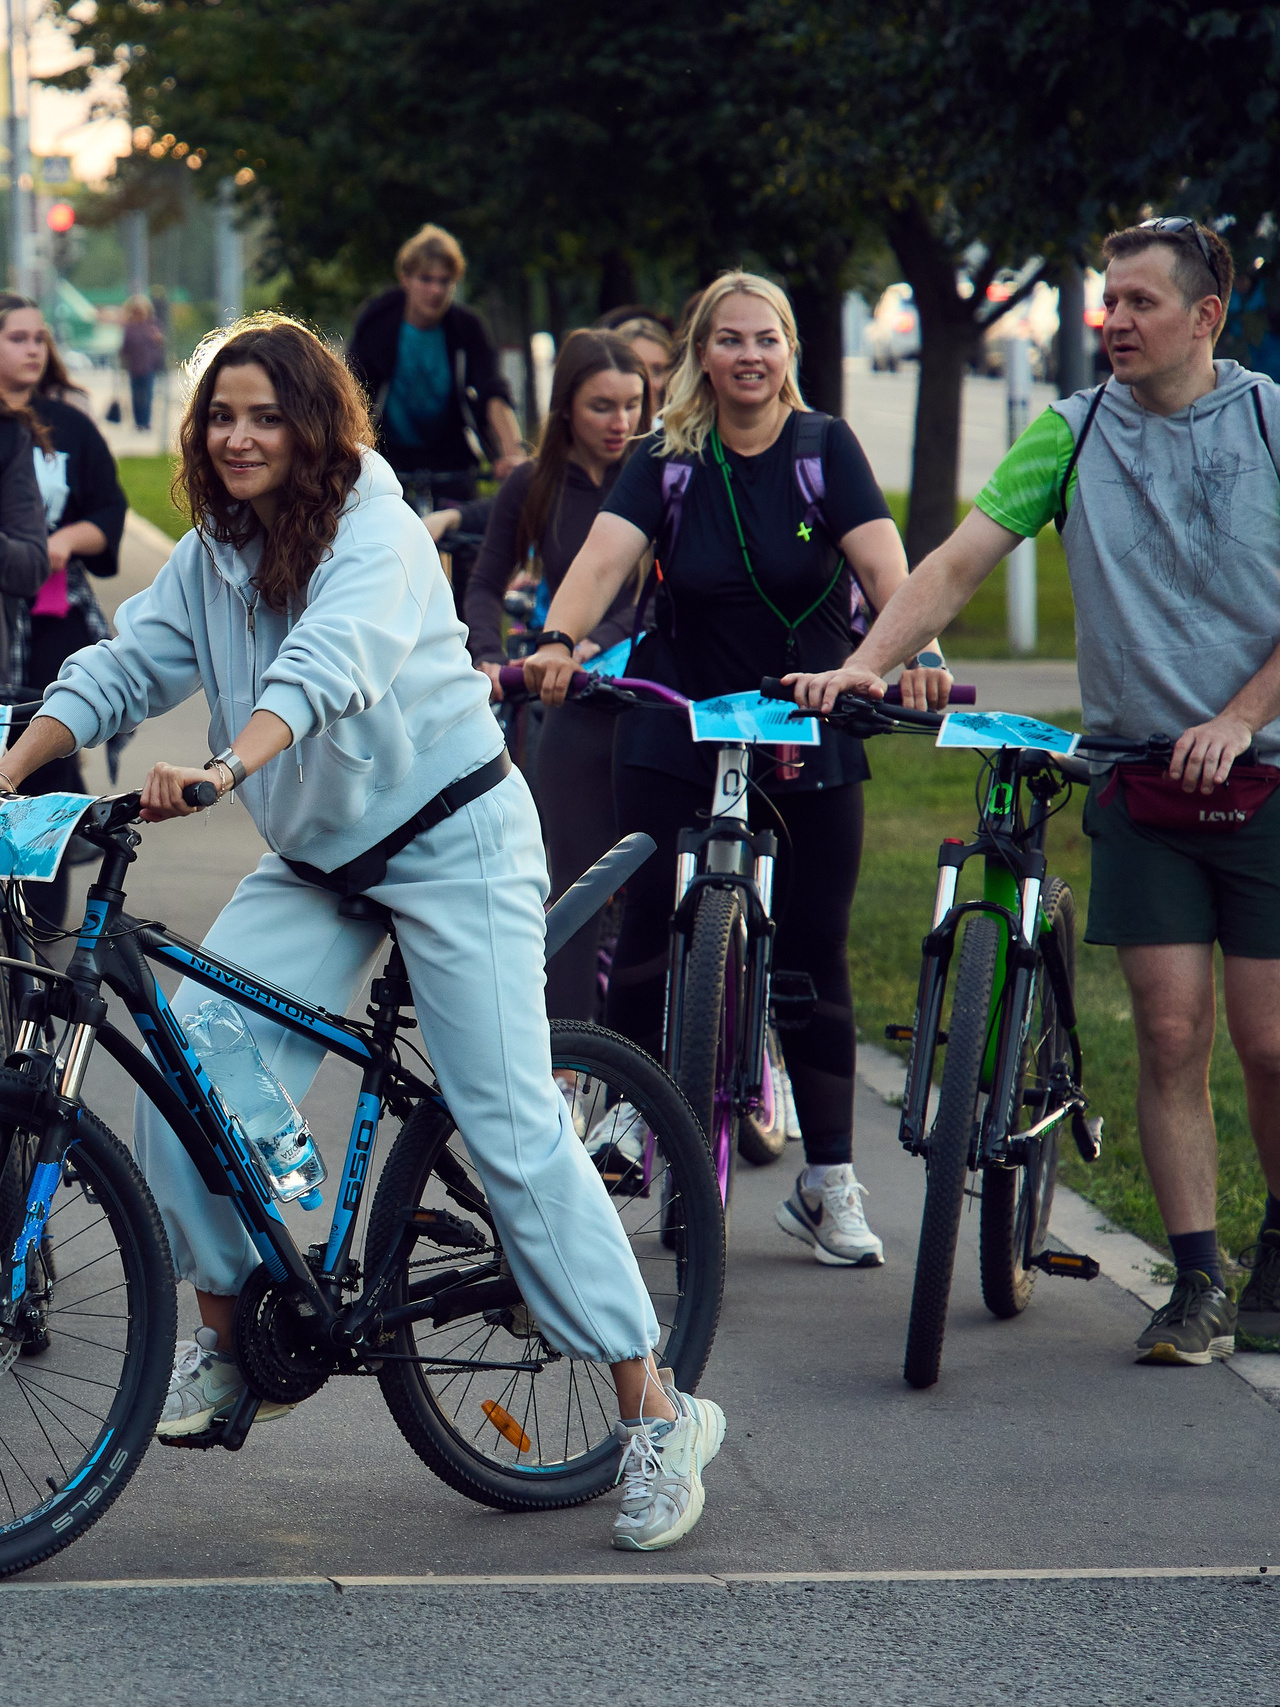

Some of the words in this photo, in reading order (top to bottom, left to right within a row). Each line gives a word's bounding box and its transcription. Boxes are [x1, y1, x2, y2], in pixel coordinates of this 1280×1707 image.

[190, 956, 315, 1027] NAVIGATOR
[343, 1120, 374, 1211] 650
[51, 1448, 129, 1534] STELS
